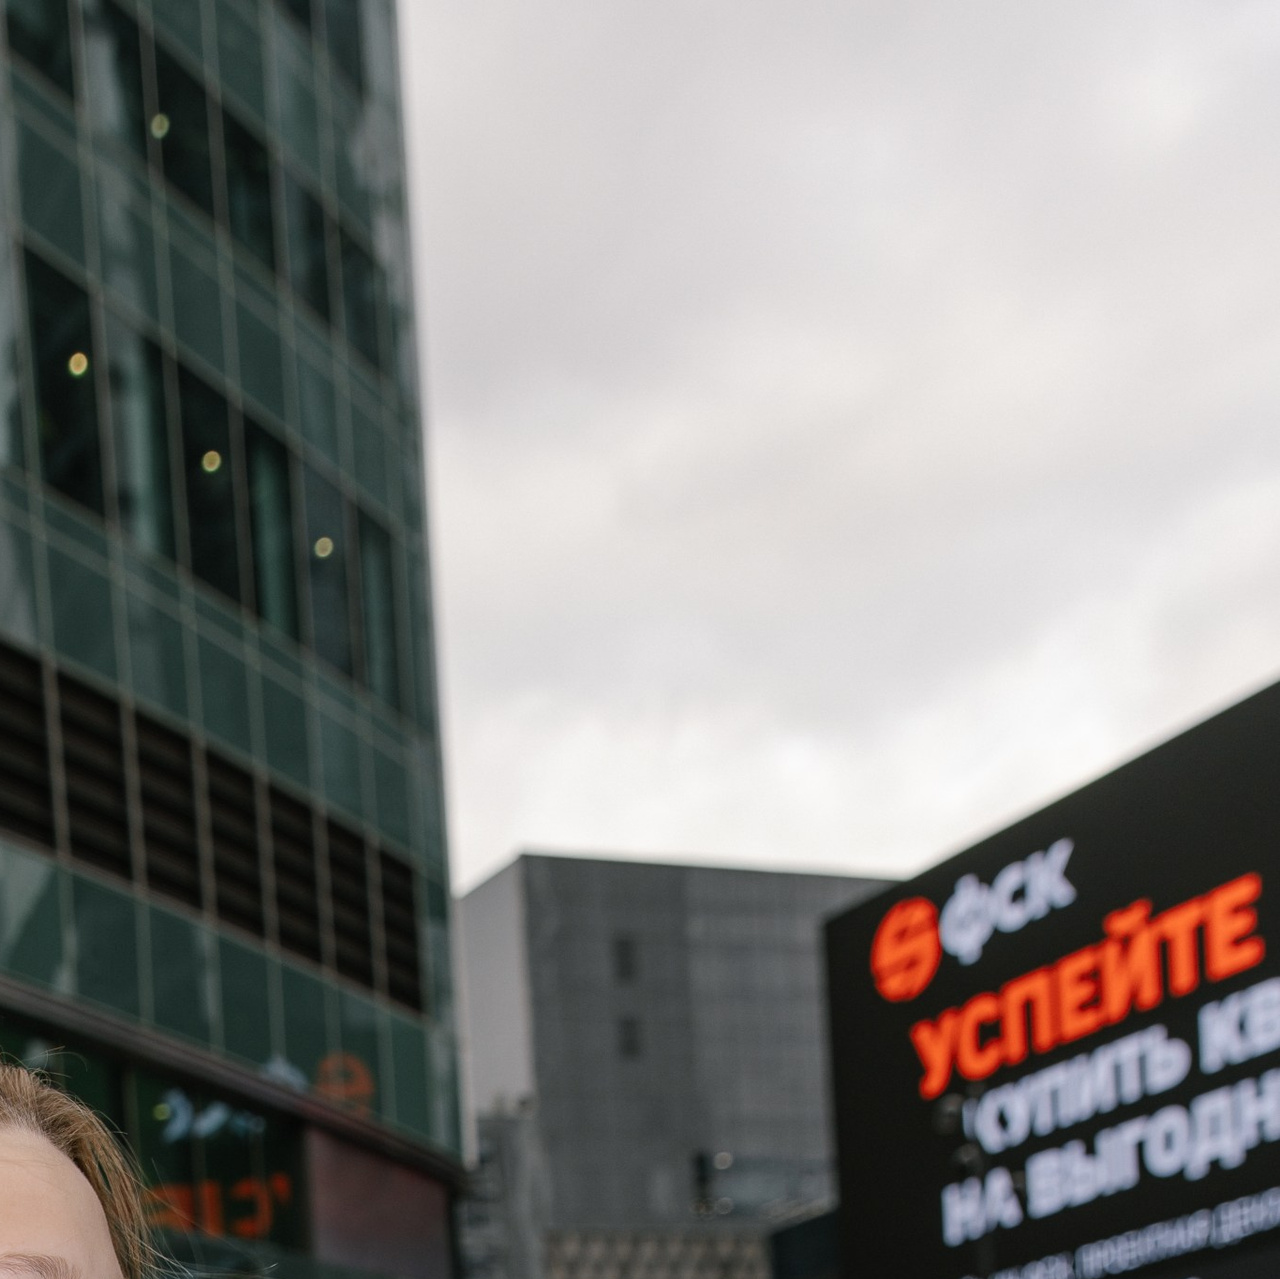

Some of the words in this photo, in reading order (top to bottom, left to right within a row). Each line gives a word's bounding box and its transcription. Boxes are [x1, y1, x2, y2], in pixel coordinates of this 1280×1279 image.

[939, 837, 1077, 966] ФСК
[909, 871, 1266, 1100] УСПЕЙТЕ
[941, 1166, 1023, 1247] НА
